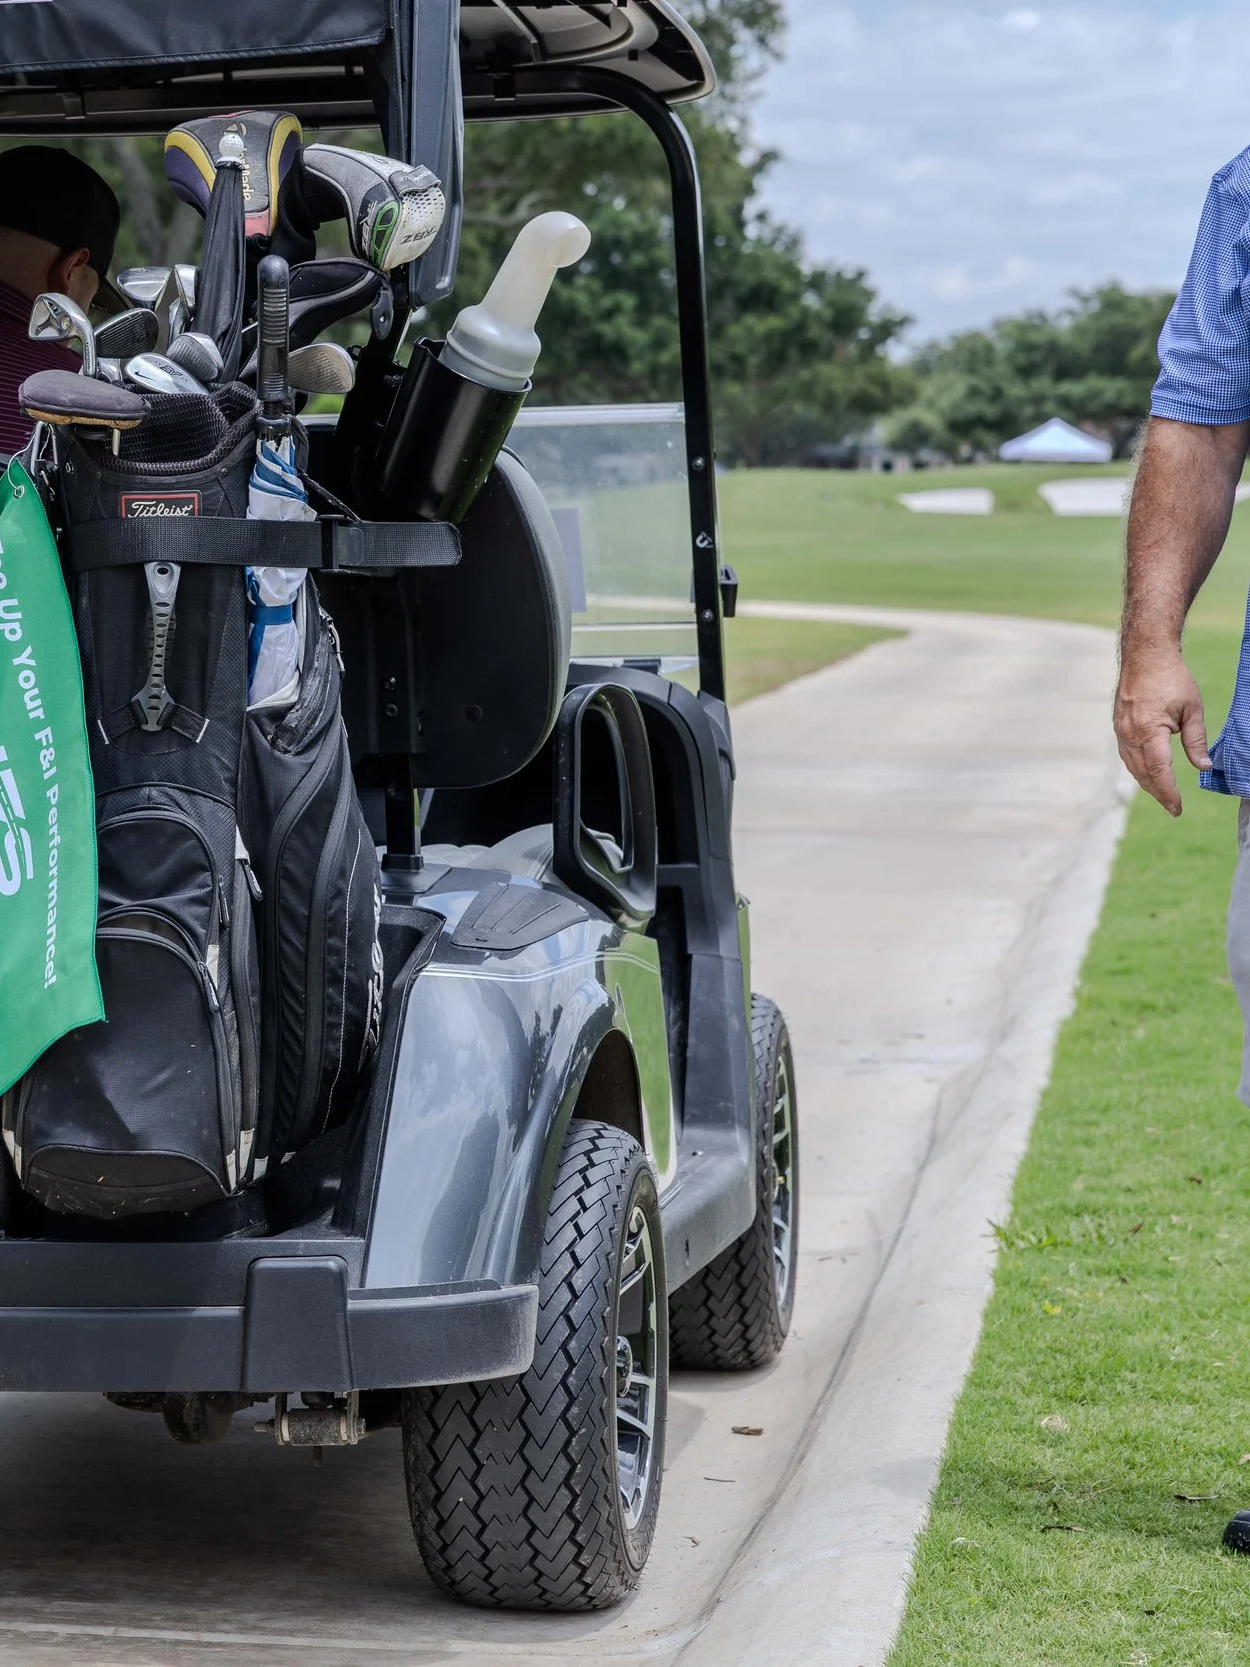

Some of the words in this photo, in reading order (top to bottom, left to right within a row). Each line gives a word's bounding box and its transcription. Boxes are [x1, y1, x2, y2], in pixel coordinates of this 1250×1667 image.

[128, 501, 191, 518] Titleist
[12, 645, 45, 720] Your
[34, 726, 56, 780] F&I
[45, 784, 61, 989] Performance!
